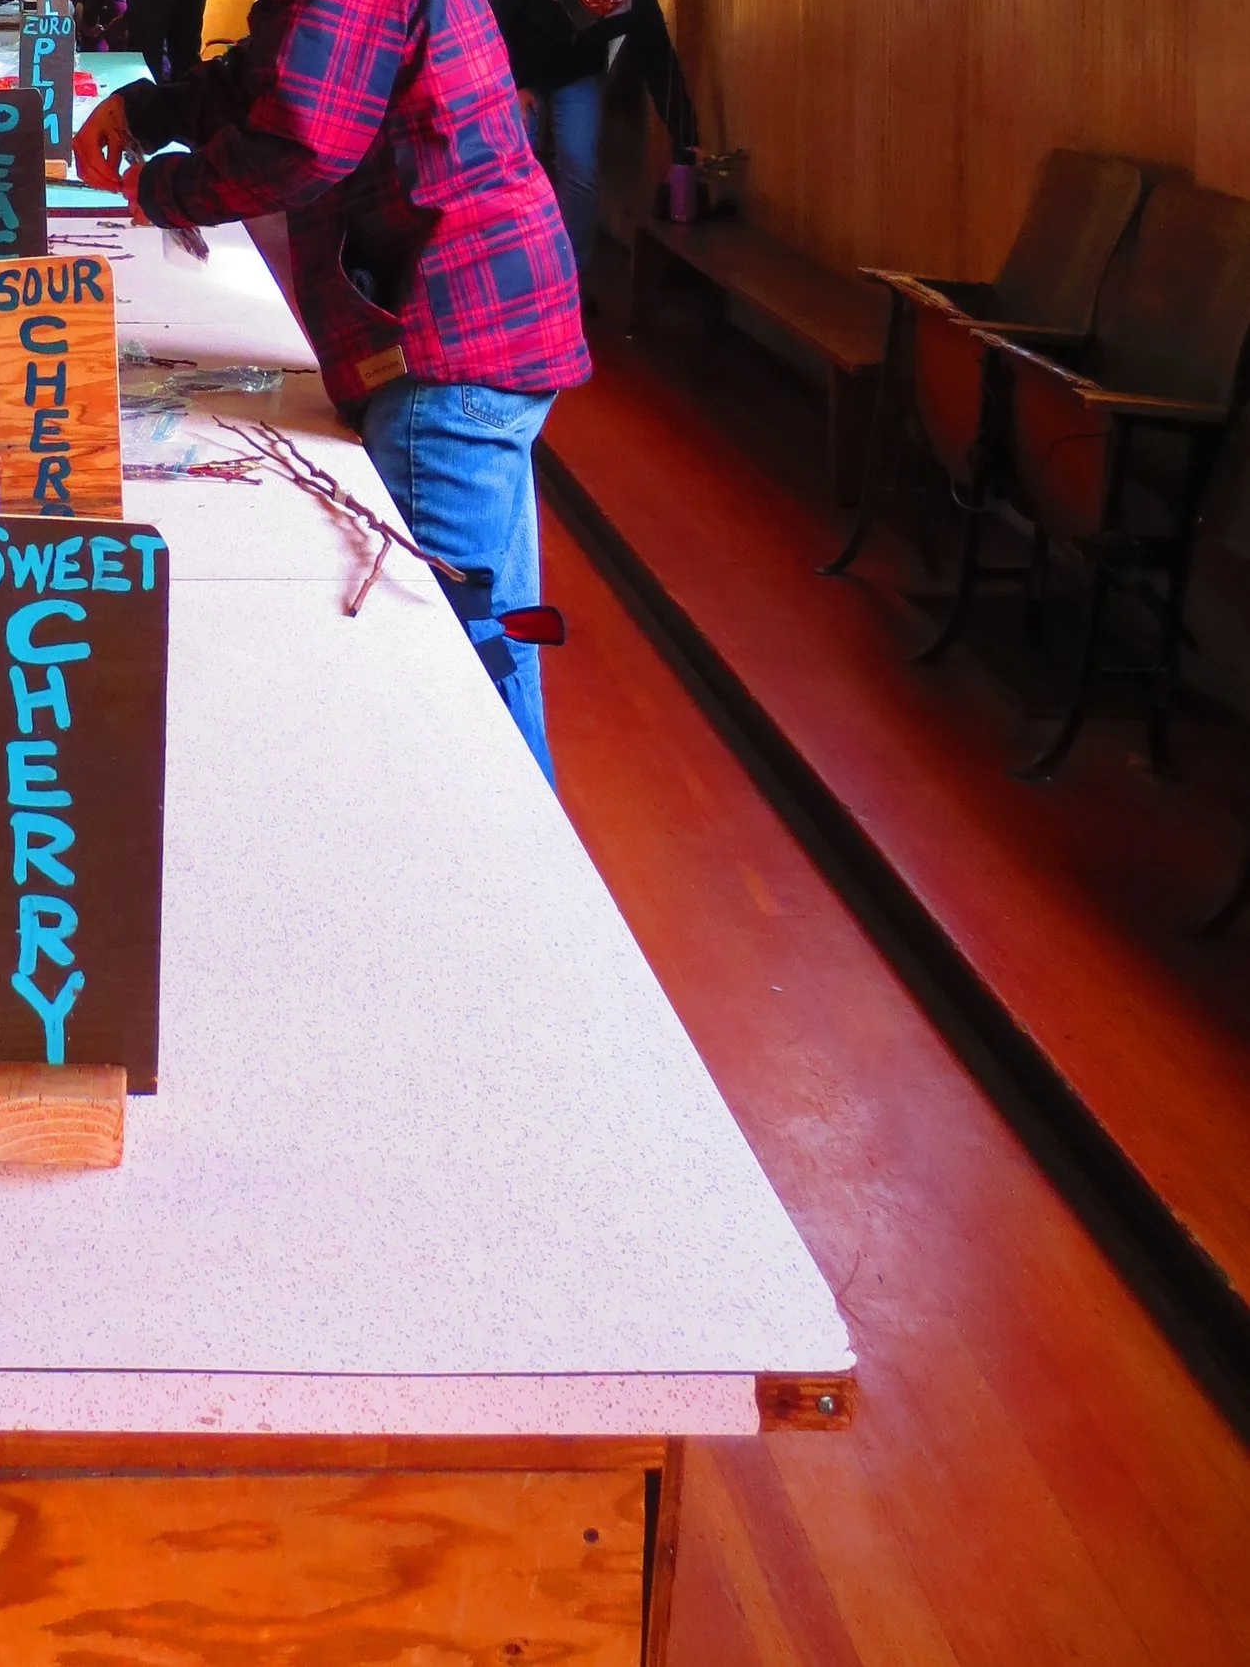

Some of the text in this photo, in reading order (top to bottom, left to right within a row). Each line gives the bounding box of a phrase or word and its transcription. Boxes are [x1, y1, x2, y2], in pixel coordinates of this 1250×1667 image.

[23, 16, 72, 35] EURO
[19, 315, 75, 518] CHER
[5, 598, 92, 1066] CHERRY
